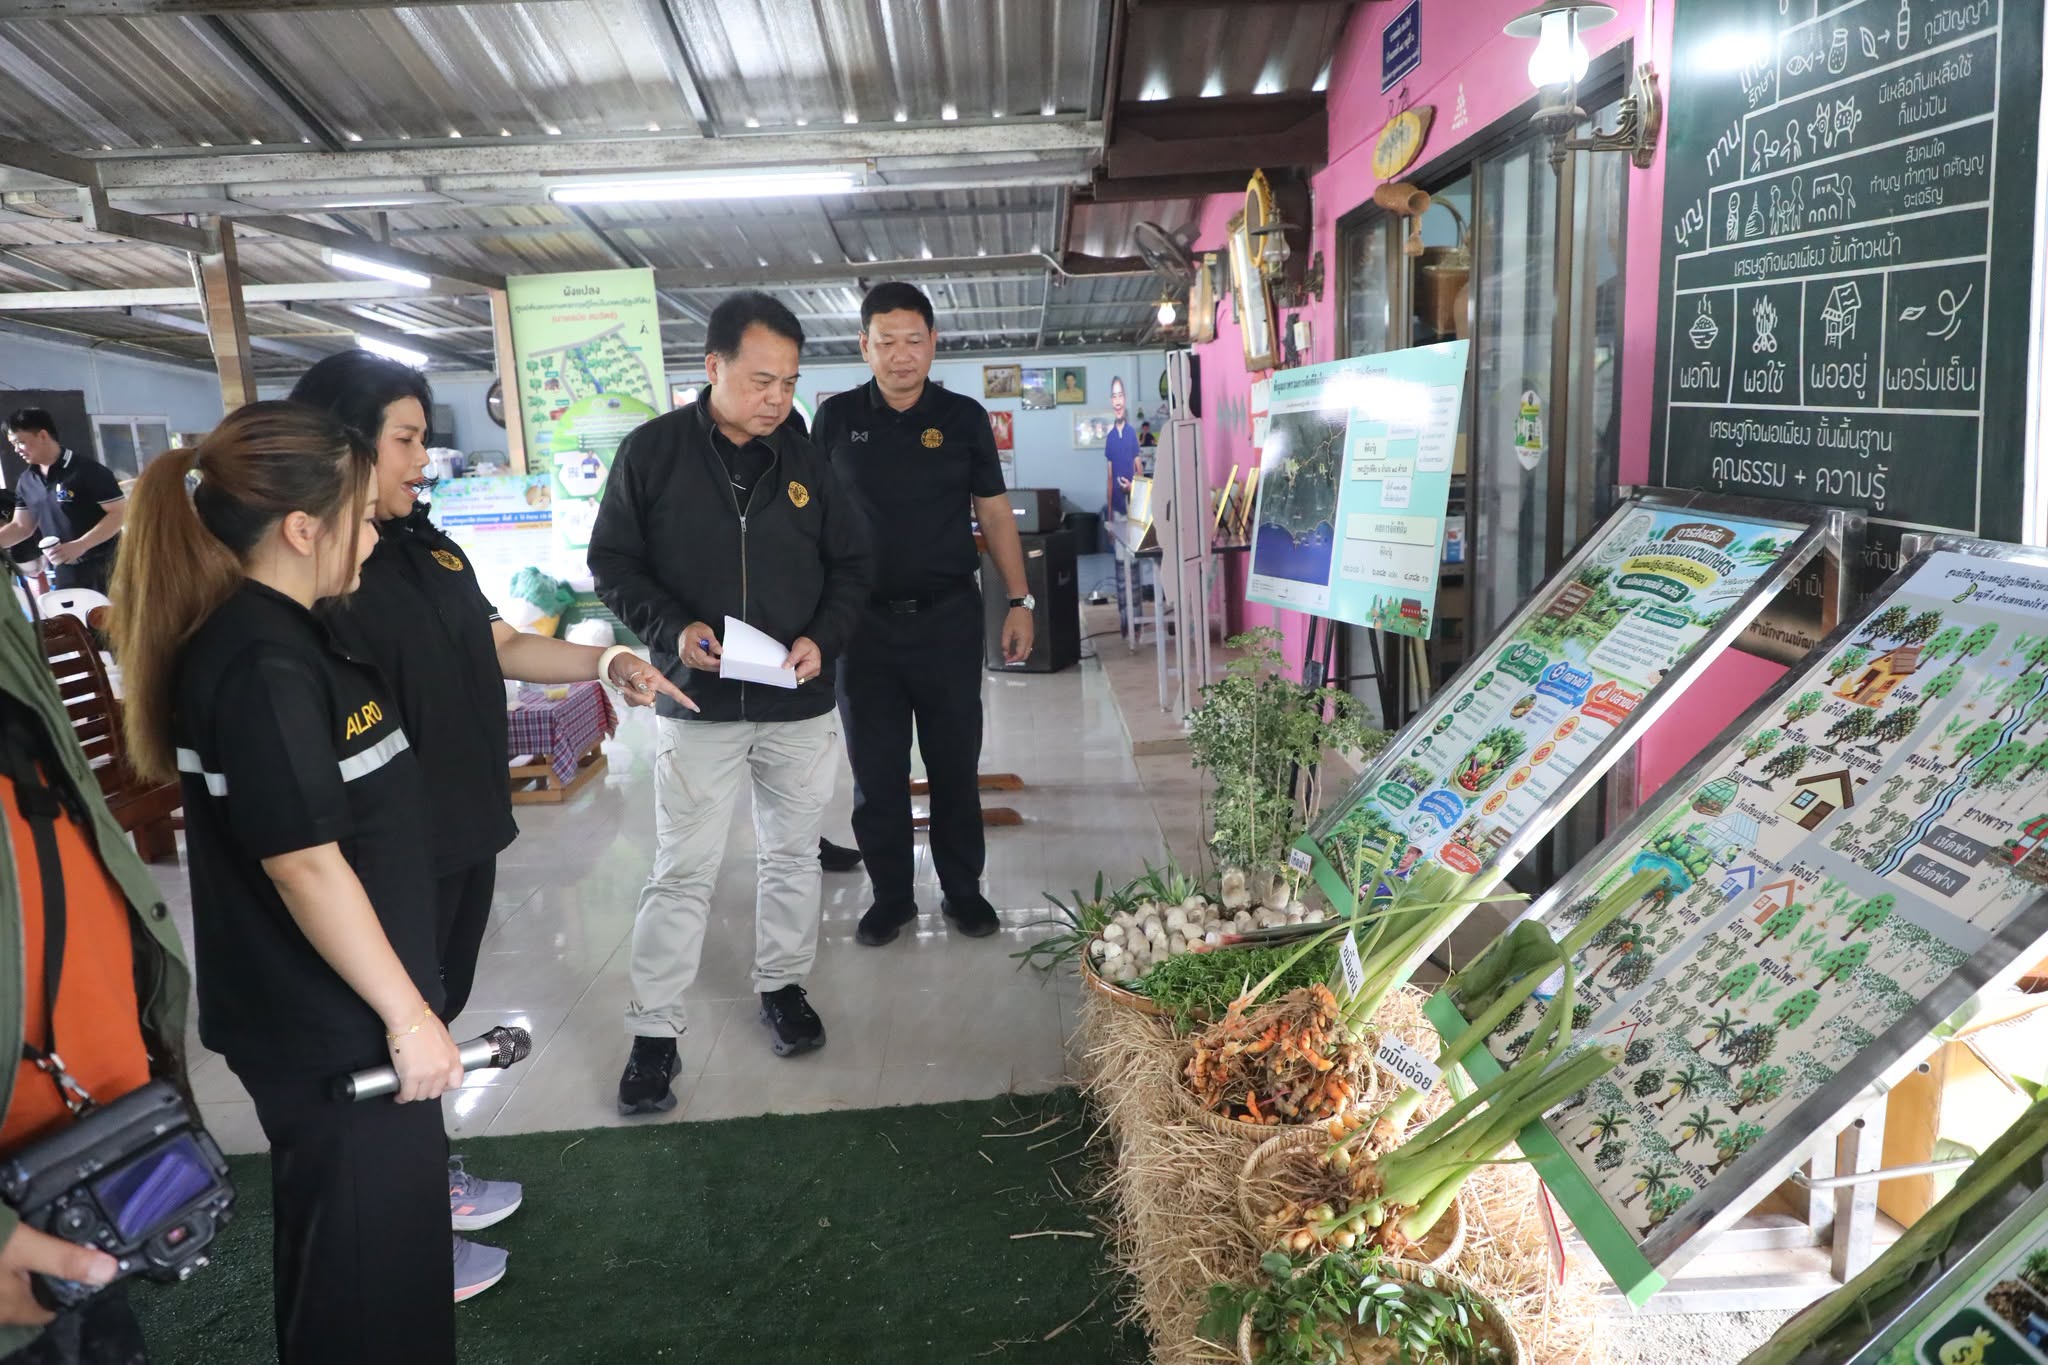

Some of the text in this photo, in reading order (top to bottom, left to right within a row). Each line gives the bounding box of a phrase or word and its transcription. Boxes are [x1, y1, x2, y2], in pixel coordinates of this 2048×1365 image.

[1879, 53, 1973, 105] มีเหลือกินเหลือใช้
[1898, 96, 1948, 126] ก็แบ่งปัน
[1706, 119, 1741, 176] ทาน
[1870, 153, 1986, 195] ทำบุญ ทำทาน กตัญญู
[1903, 185, 1944, 208] จะเจริญ
[1674, 198, 1704, 248] บุญ
[1734, 233, 1902, 280] เศรษฐกิจพอเพียง ขั้นก้าวหน้า
[1680, 352, 1976, 400] พอกิน พอใช้ พออยู่ พอร่มเย็น
[1709, 414, 1893, 460] เศรษฐกิจพอเพียง ขั้นพื้นฐาน
[1712, 456, 1889, 511] คุณธรรม + ความรู้
[1677, 524, 1726, 543] การส่งเสริม
[1891, 684, 1919, 705] มังคุด
[346, 701, 383, 740] ALRO
[1781, 727, 1810, 744] ทุเรียน
[1905, 753, 1948, 775] สมุนไพร
[1963, 807, 2014, 834] ยางพารา
[1789, 860, 1825, 886] ห้องน้ำ
[1759, 957, 1798, 987] สมุนไพร
[1379, 1046, 1433, 1089] ขมิ้นอ้อย
[1681, 1160, 1710, 1190] ทุเรียน
